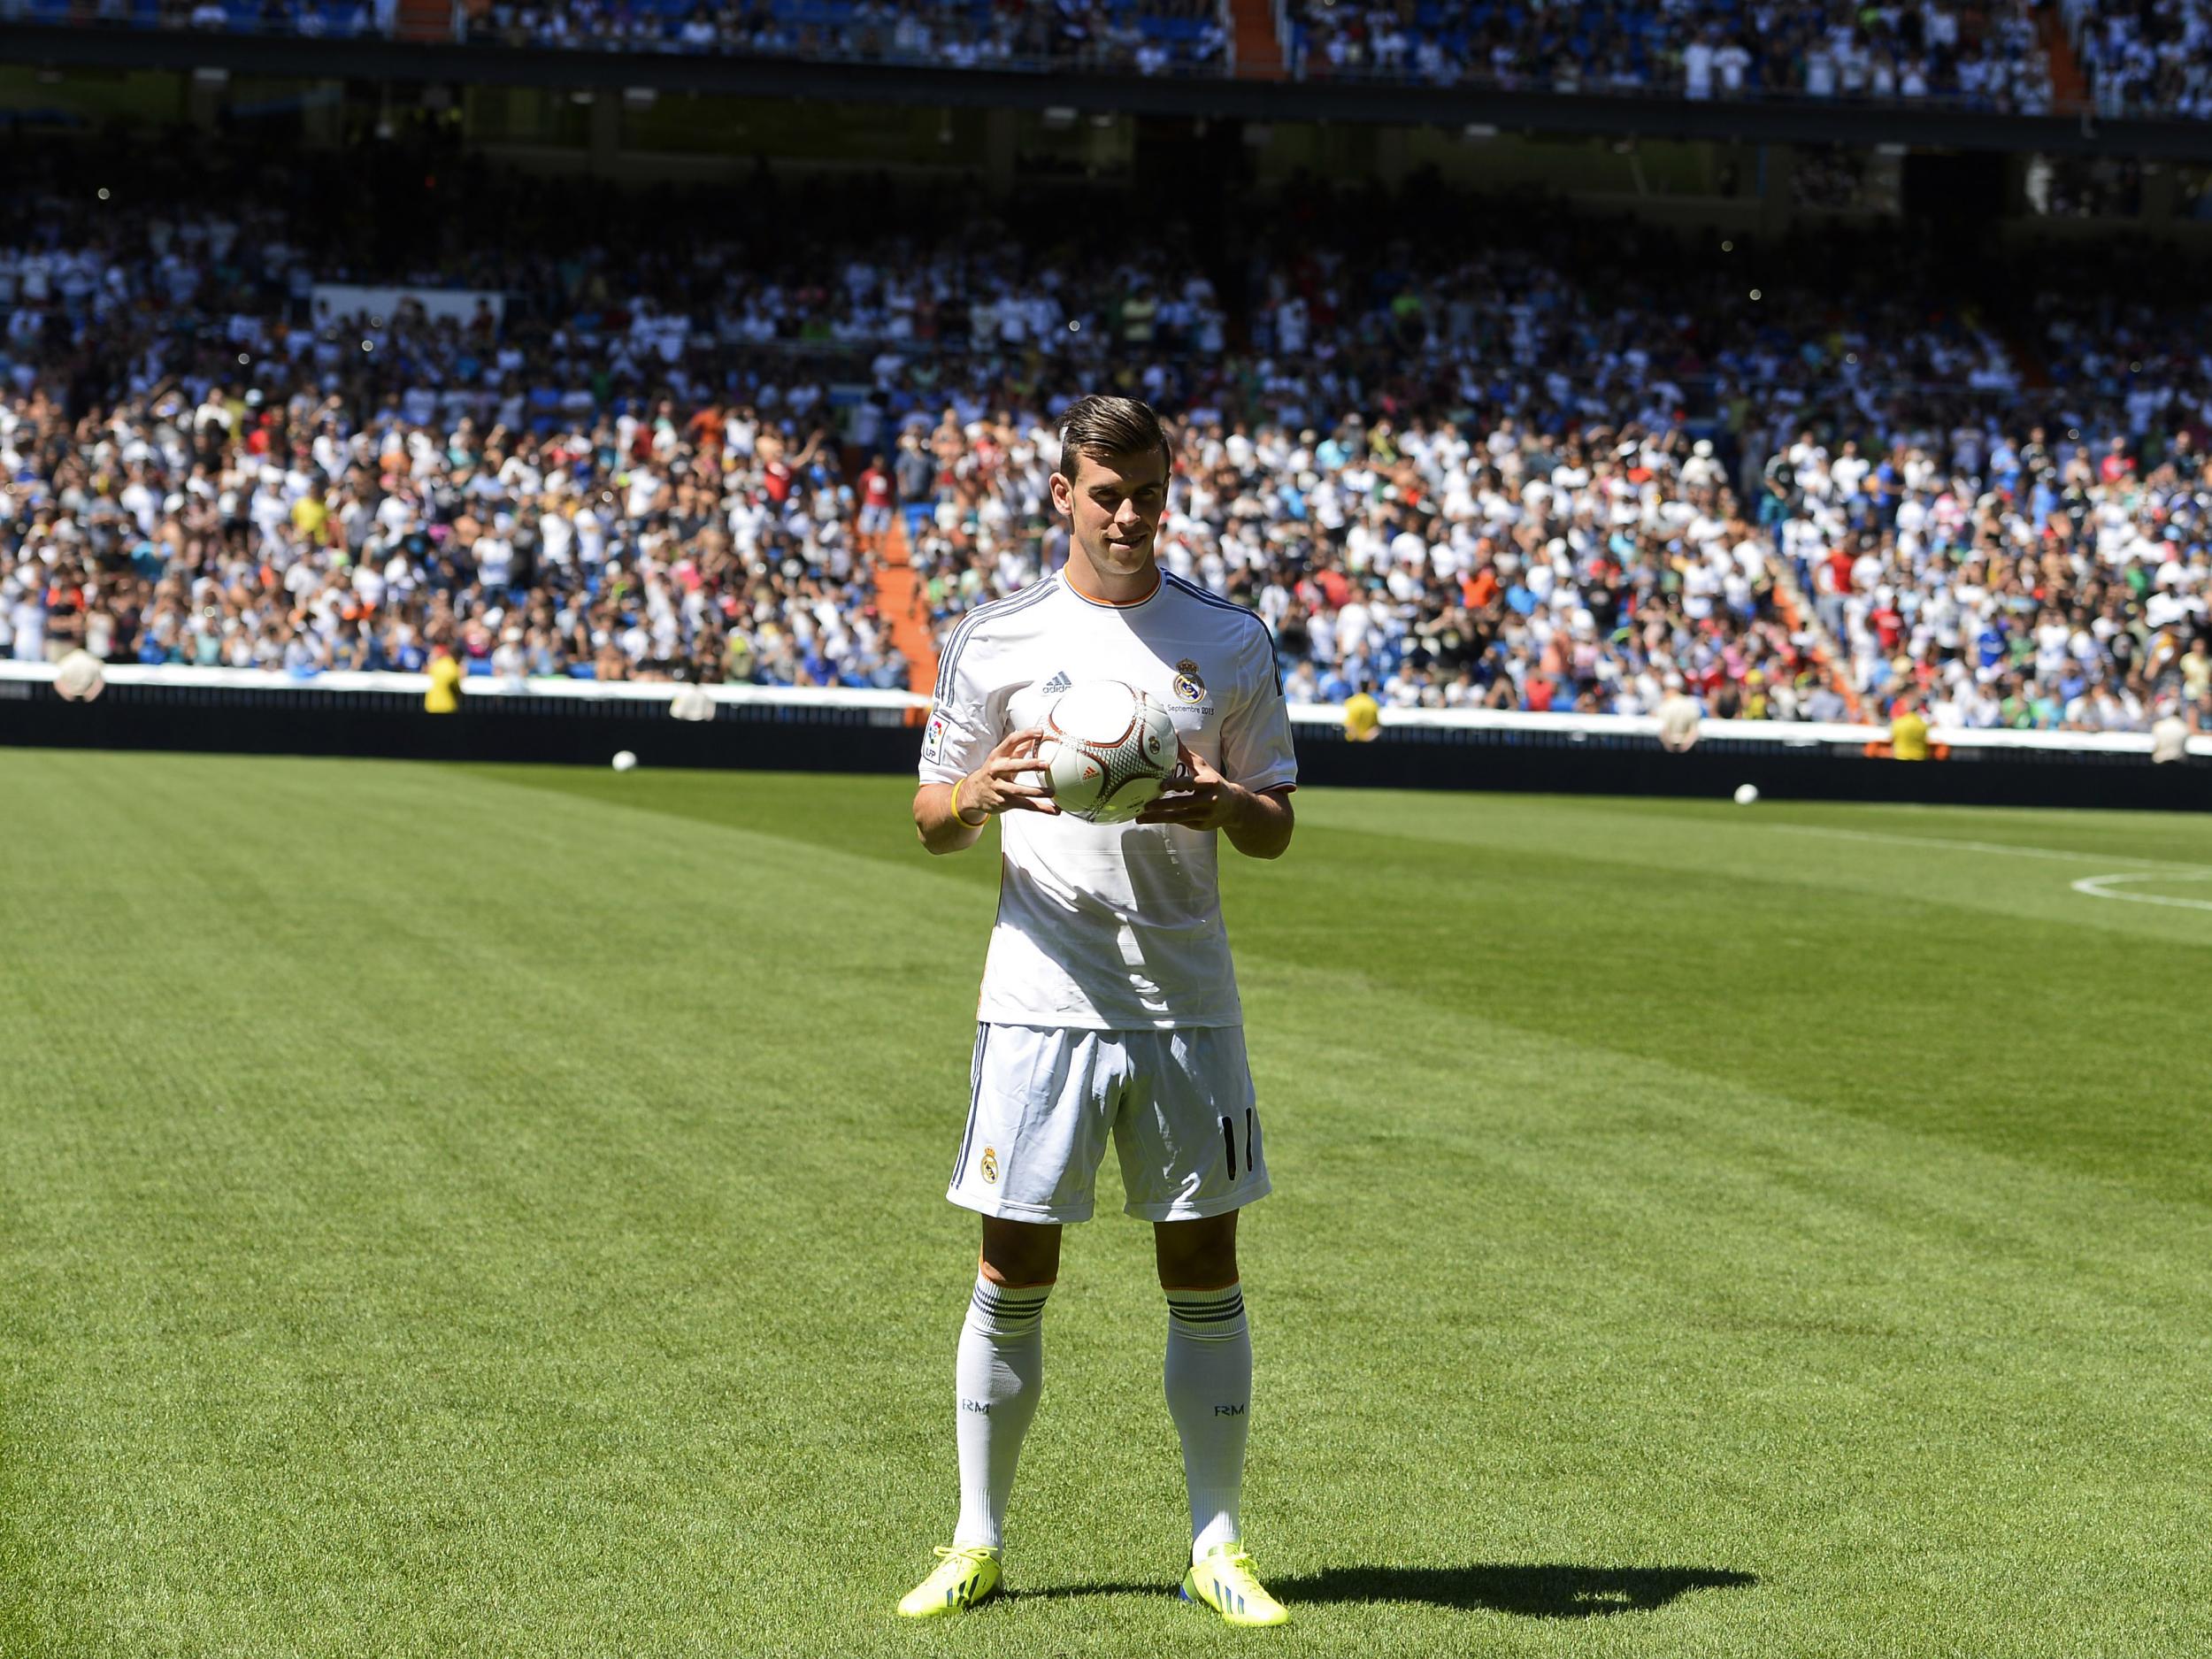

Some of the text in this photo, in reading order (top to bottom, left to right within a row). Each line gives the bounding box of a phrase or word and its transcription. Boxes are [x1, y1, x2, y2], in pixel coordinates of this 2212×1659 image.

[1201, 706, 1215, 716] 2013
[926, 747, 936, 758] LFP
[1222, 1107, 1253, 1181] 11
[962, 1398, 990, 1414] RM
[1214, 1402, 1245, 1417] RM
